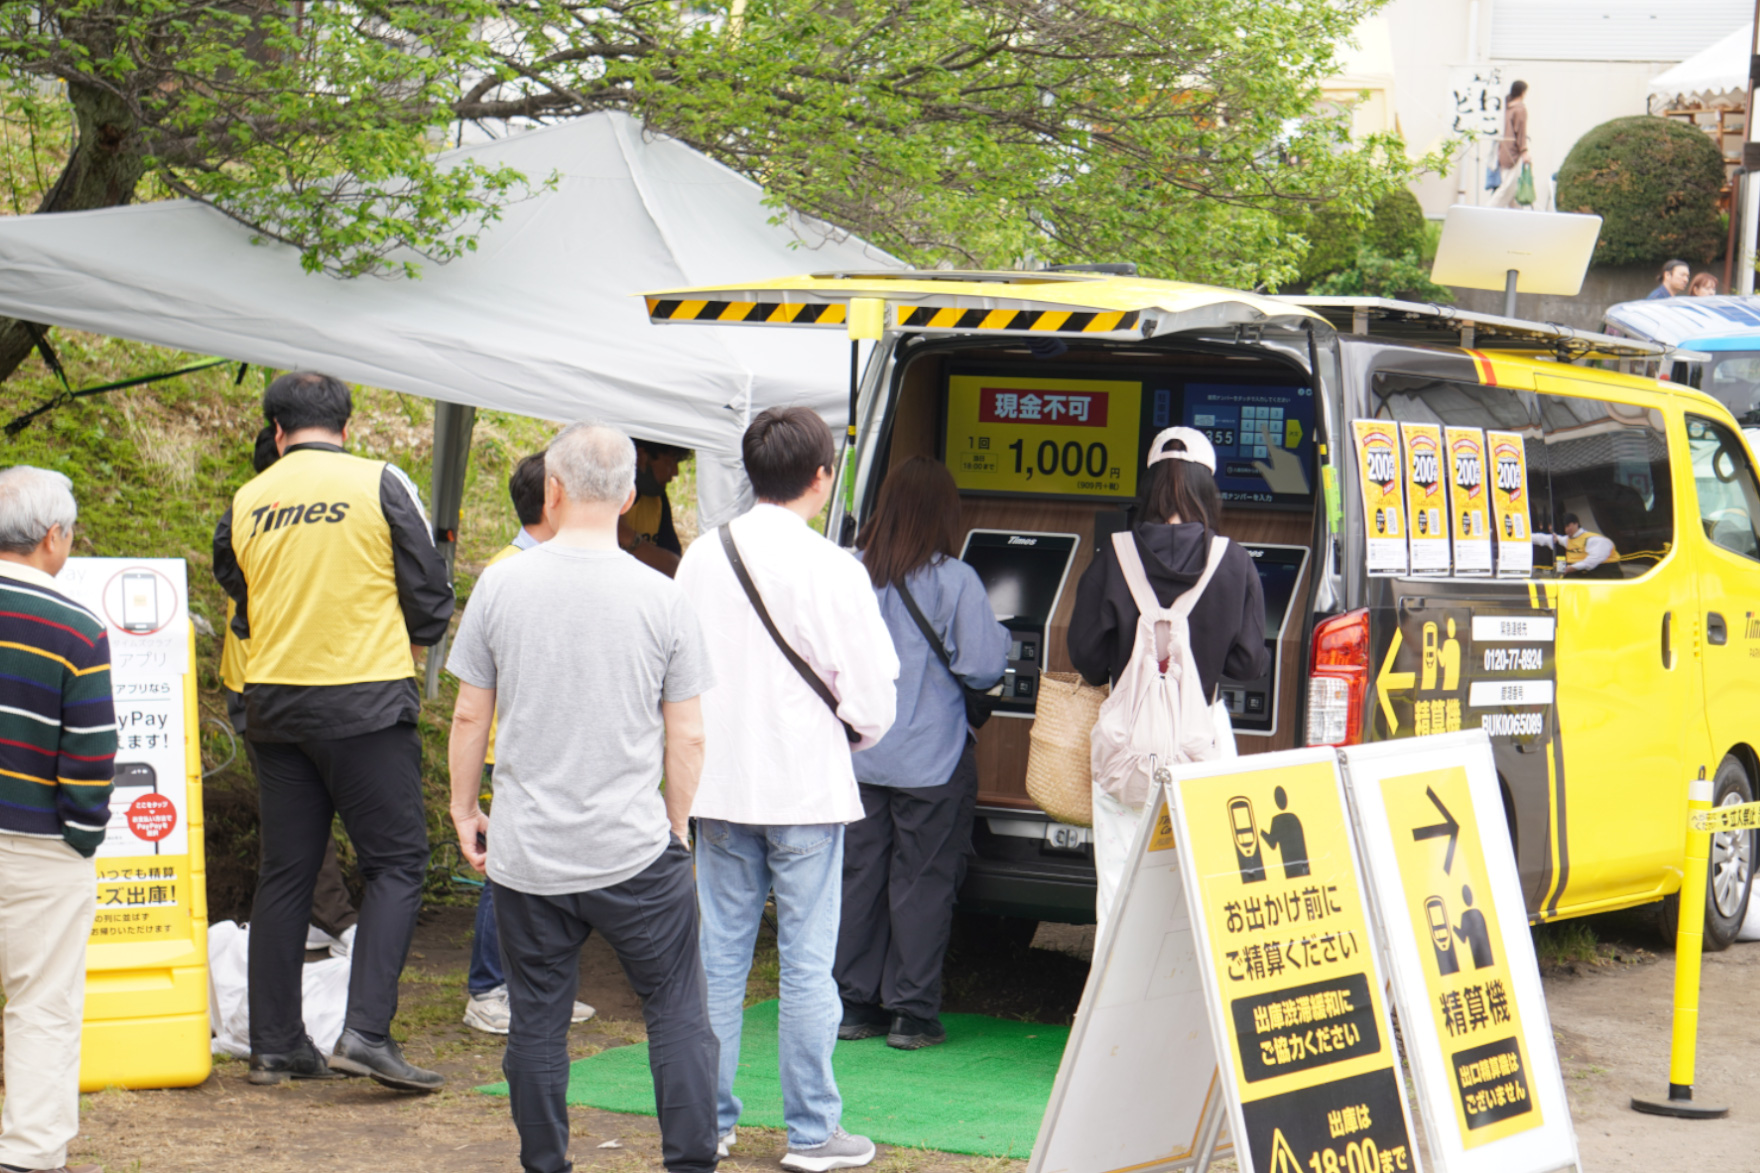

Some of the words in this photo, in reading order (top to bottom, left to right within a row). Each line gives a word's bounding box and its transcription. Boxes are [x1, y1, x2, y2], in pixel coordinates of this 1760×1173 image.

[994, 393, 1092, 421] 現金不可
[250, 501, 350, 538] Times
[1007, 535, 1037, 546] Times
[118, 651, 167, 669] アプリ
[1484, 648, 1543, 671] 0120-77-8924
[1414, 698, 1461, 737] 精算機
[1481, 713, 1543, 737] BUK0065089
[1224, 885, 1342, 933] お出かけ前に
[1225, 930, 1358, 981] ご精算ください
[1253, 989, 1354, 1034] 出庫渋滞緩和に
[1439, 978, 1511, 1038] 精算機
[1260, 1022, 1360, 1066] ご協力ください
[1459, 1051, 1519, 1088] 出口精算機は
[1464, 1079, 1527, 1115] ございません
[1327, 1103, 1372, 1139] 出庫は
[1308, 1137, 1408, 1173] 18:00まで
